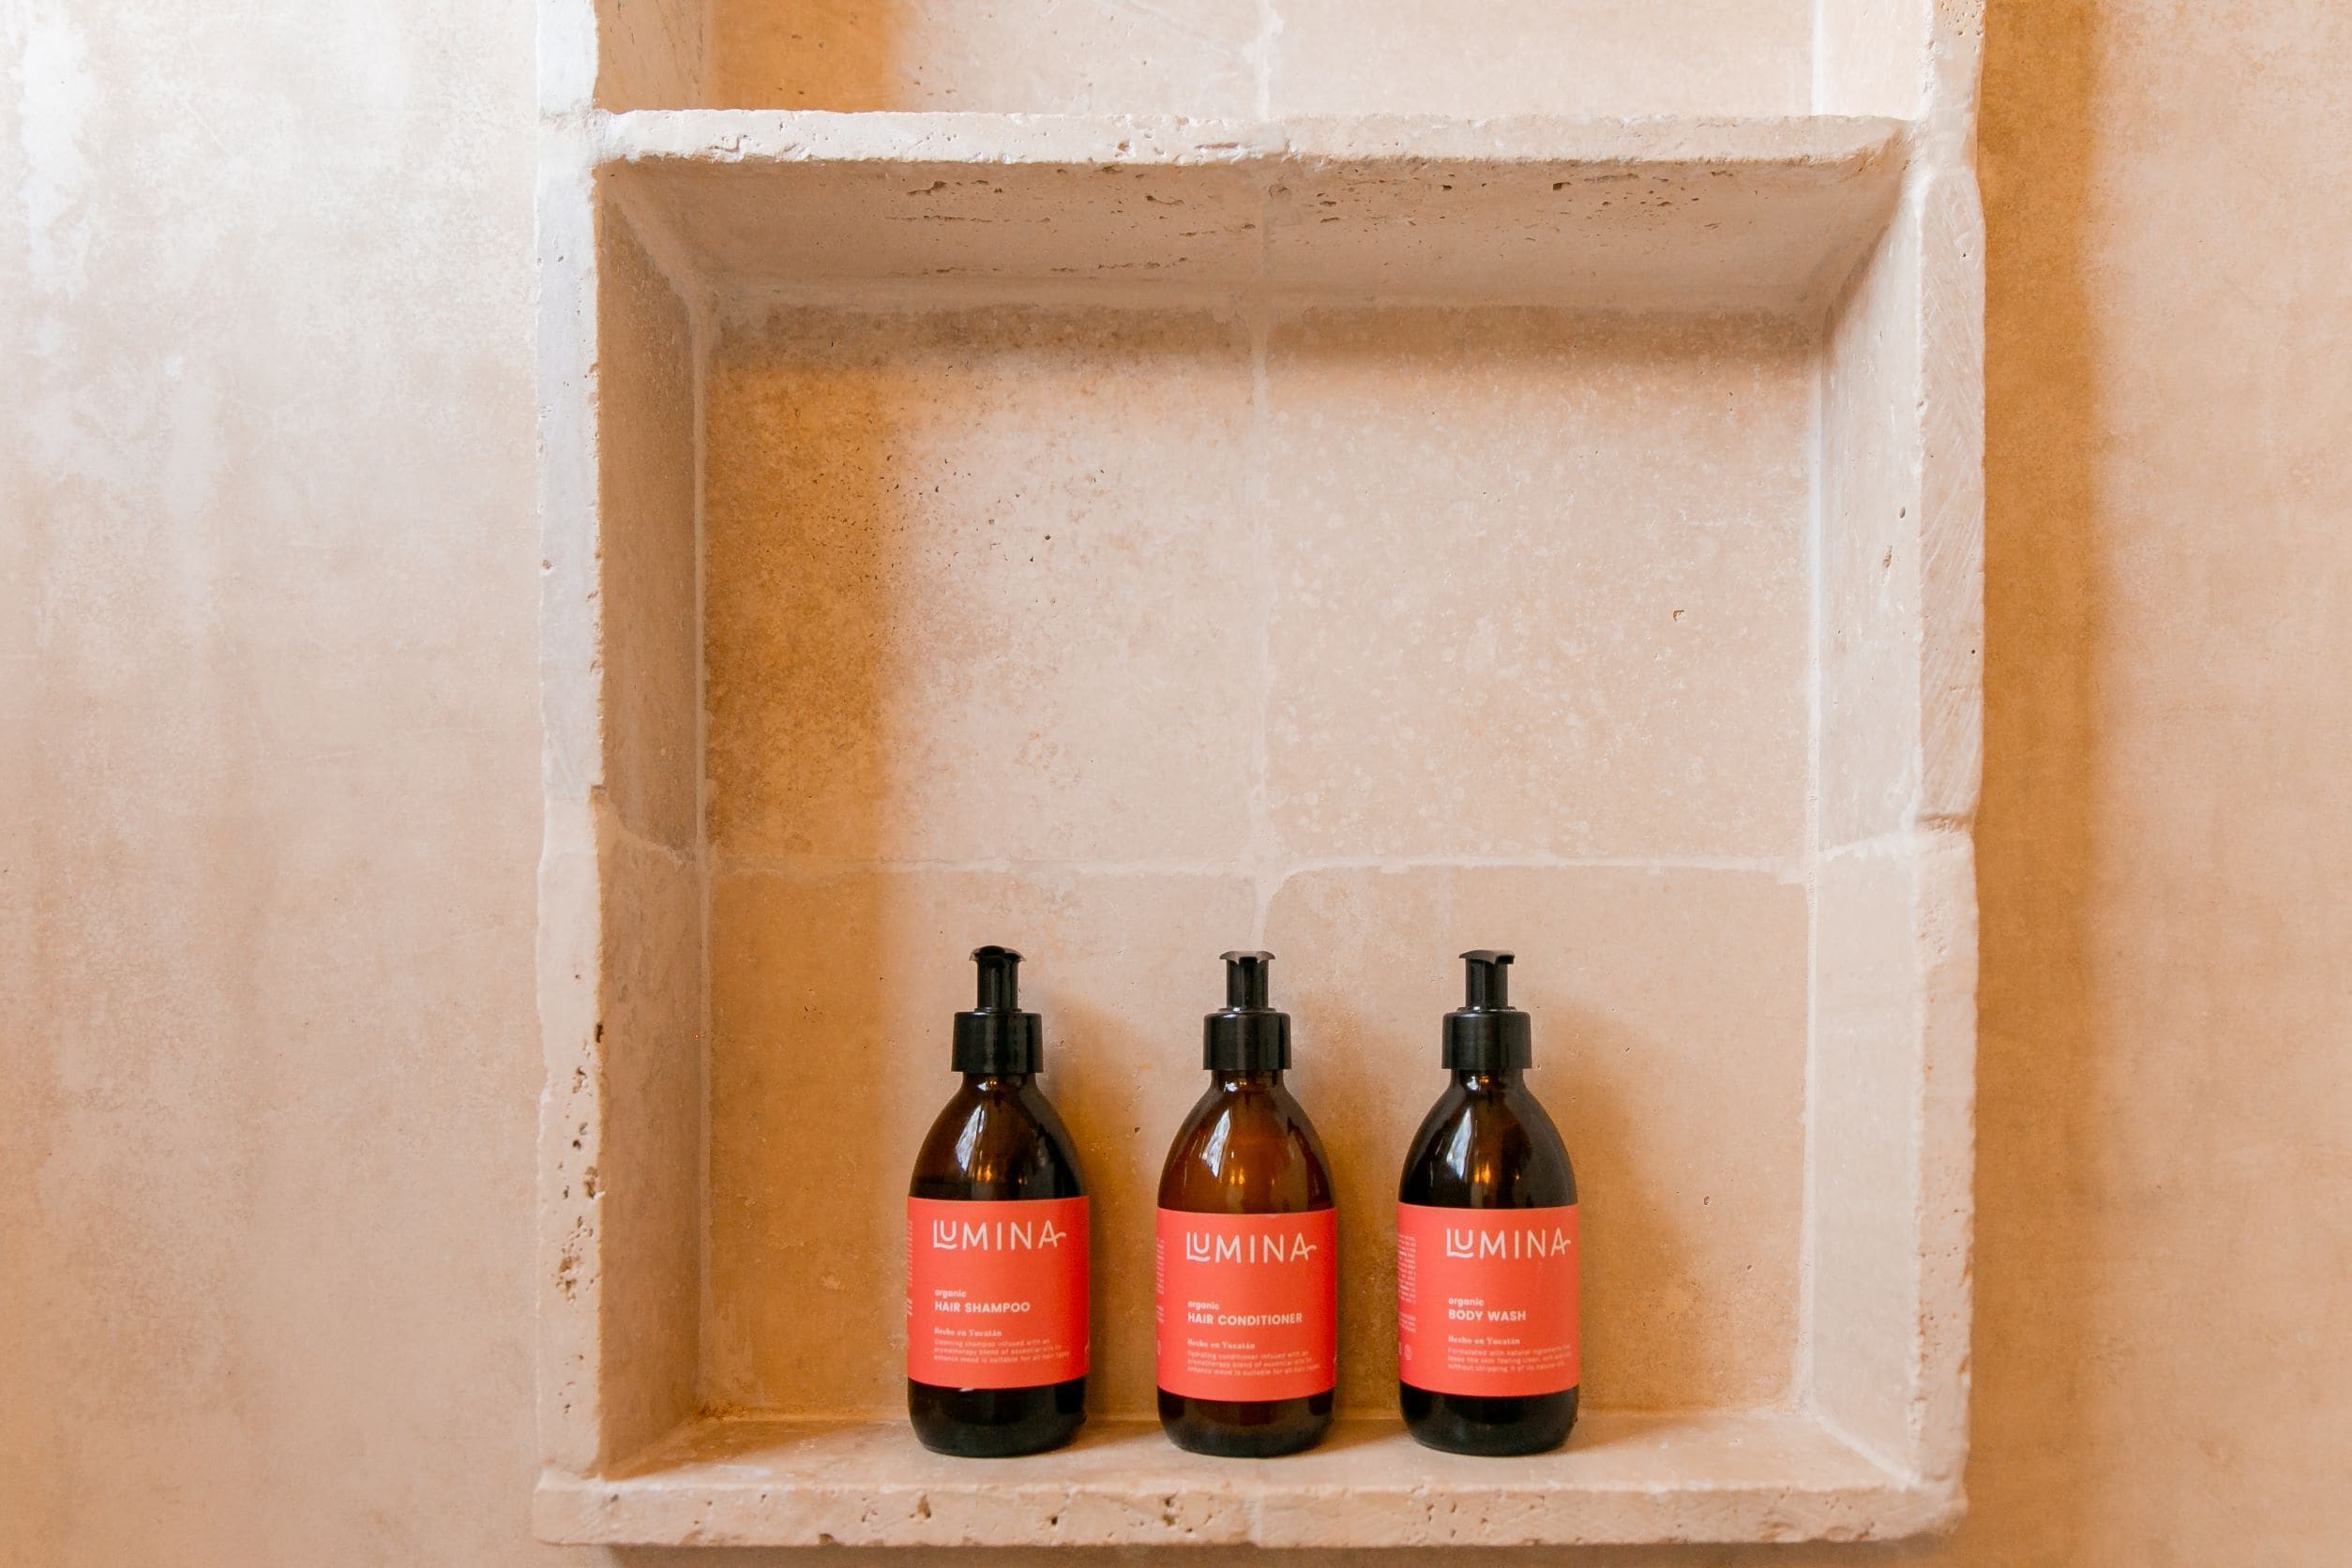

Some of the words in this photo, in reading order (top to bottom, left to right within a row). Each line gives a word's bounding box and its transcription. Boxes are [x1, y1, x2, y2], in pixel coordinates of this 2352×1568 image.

[933, 1220, 1066, 1251] LUMINA
[1186, 1232, 1317, 1263] LUMINA
[1446, 1228, 1571, 1259] LUMINA
[934, 1289, 966, 1298] organic
[935, 1302, 960, 1312] HAIR
[965, 1302, 1031, 1313] SHAMPOO
[1187, 1301, 1219, 1310] organic
[1448, 1298, 1484, 1307] organic
[1187, 1313, 1214, 1324] HAIR
[1218, 1313, 1303, 1326] CONDITIONER
[1449, 1309, 1482, 1320] BODY
[1487, 1311, 1526, 1320] WASH
